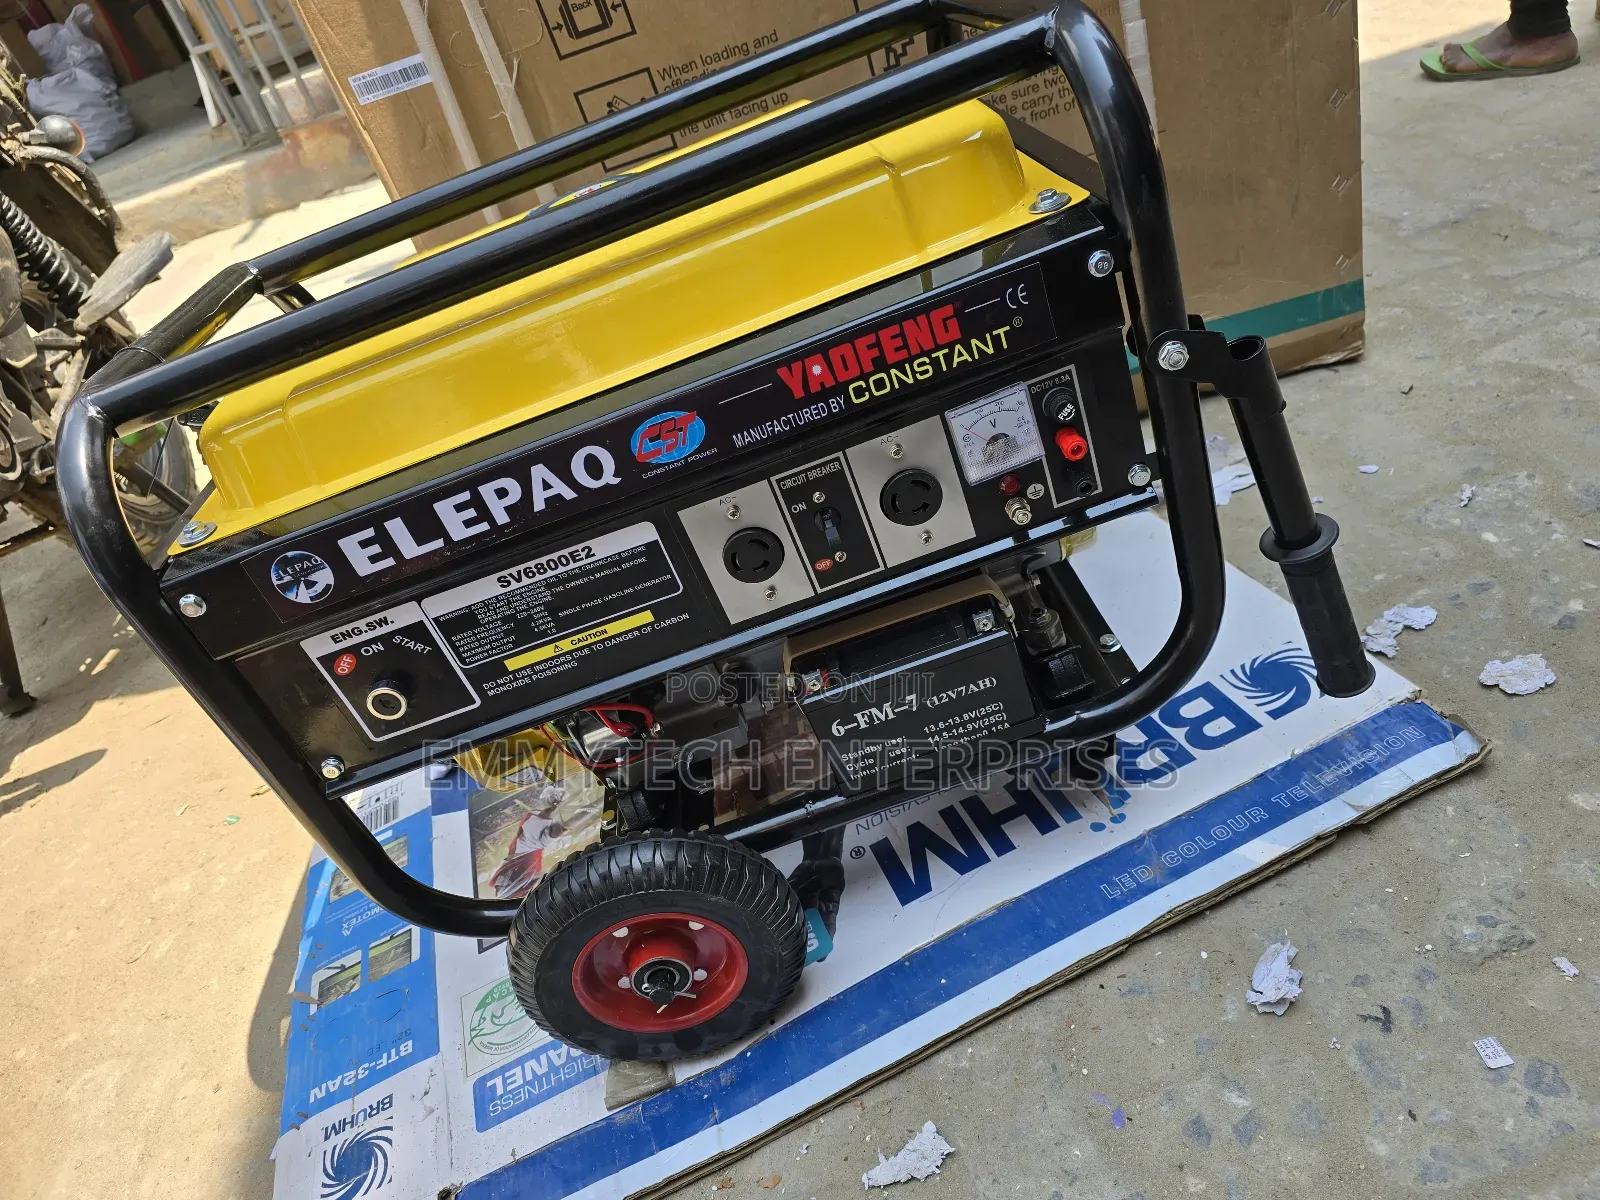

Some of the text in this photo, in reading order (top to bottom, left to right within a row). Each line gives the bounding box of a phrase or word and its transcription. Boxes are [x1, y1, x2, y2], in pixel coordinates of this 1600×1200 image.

[570, 0, 593, 14] Back
[656, 29, 780, 82] When loading and
[1011, 82, 1040, 100] sure
[1044, 73, 1067, 89] two
[1021, 92, 1054, 112] carry
[1058, 86, 1073, 99] th
[703, 109, 728, 130] unit
[728, 97, 769, 122] facing
[771, 90, 789, 108] up
[1030, 104, 1061, 124] front
[1063, 97, 1076, 112] of
[777, 304, 962, 400] YAOFENG
[1030, 373, 1072, 395] DC12V 8.3A
[733, 394, 847, 449] MANUFACTURED BY
[988, 418, 997, 429] V
[1057, 402, 1075, 421] FUSE
[636, 410, 697, 463] CST
[642, 447, 718, 480] CONSTANT POWER
[780, 461, 842, 490] CIRCUIT BREAKER
[337, 445, 622, 577] ELEPAQ
[791, 502, 807, 514] ON
[496, 545, 596, 589] SV6800E2
[816, 559, 832, 571] OFF
[330, 615, 395, 645] ENG.SW.
[570, 628, 609, 647] CAUTION
[360, 642, 385, 656] ON
[392, 635, 432, 655] START
[482, 612, 690, 690] DO NOT USE INDOORS DUE TO DANGER OF CARBON
[338, 655, 353, 674] OFF
[487, 661, 579, 697] MONOXIDE POISONING
[926, 676, 998, 709] (12V7AH)
[841, 743, 883, 761] Standby
[884, 734, 908, 748] use:
[846, 757, 875, 772] Cycle
[888, 746, 911, 758] use:
[1100, 725, 1427, 900] LED COLOUR TELEVISION
[309, 1040, 413, 1104] BTF-32AN
